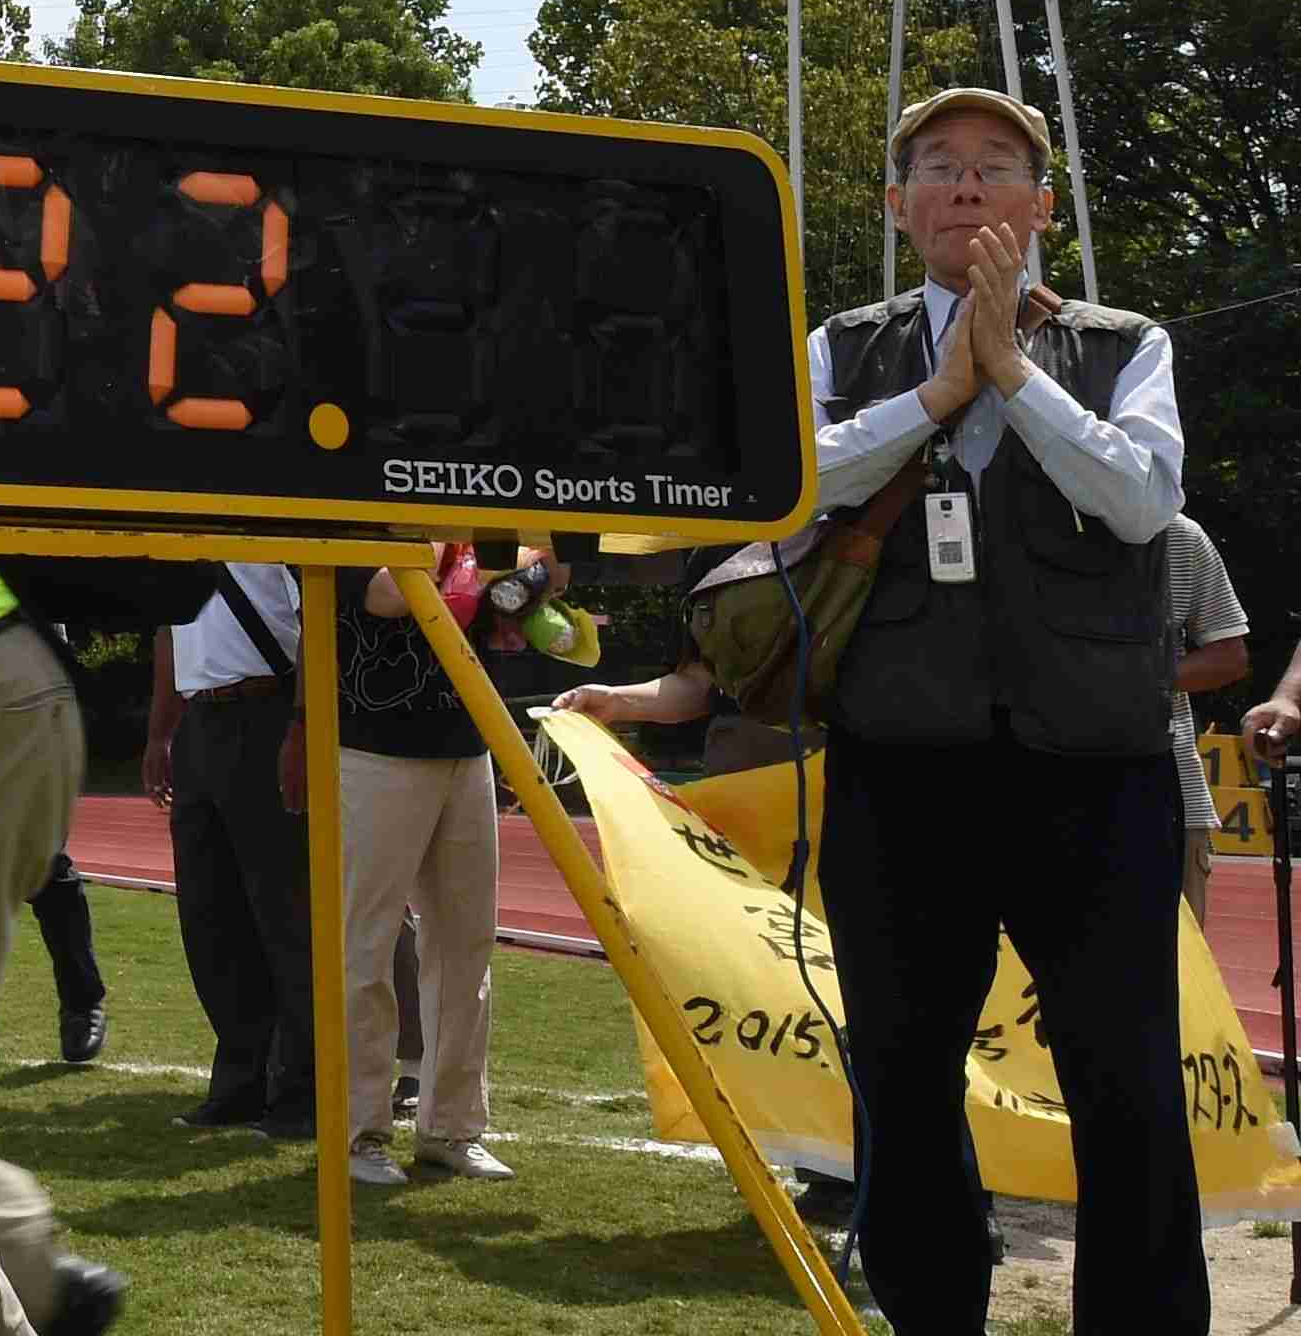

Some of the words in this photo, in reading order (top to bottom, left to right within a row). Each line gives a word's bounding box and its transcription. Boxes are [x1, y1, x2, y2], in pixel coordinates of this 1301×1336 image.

[383, 459, 523, 497] SEIKO
[534, 468, 636, 505] Sports
[645, 474, 732, 507] Timer
[1220, 800, 1255, 842] 4
